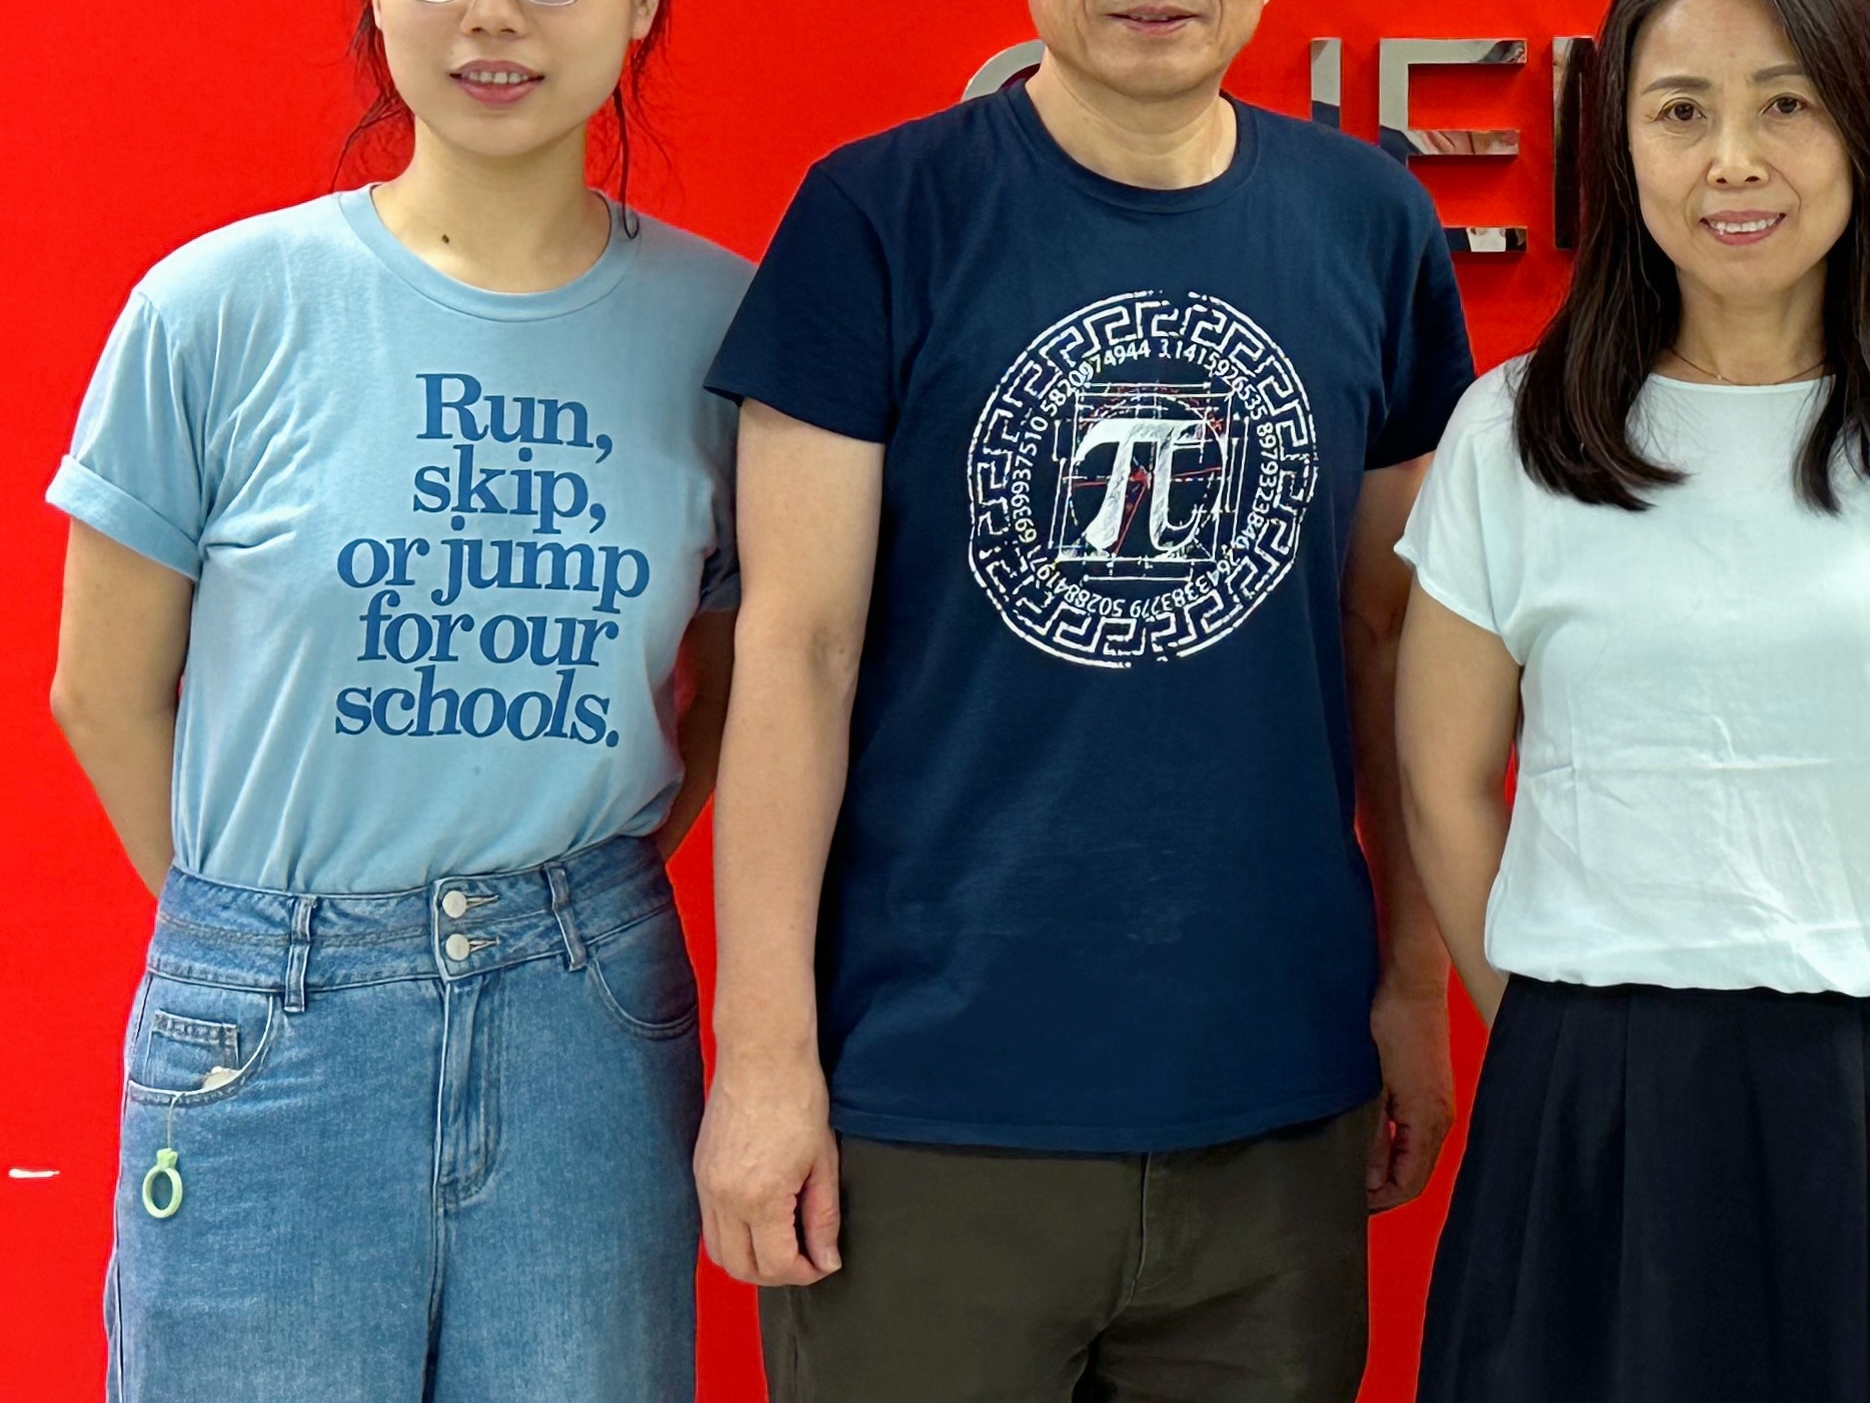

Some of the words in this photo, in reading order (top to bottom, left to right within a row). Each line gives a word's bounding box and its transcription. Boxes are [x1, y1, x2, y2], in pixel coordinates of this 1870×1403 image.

[415, 372, 614, 464] Run,
[412, 444, 607, 534] skip,
[336, 536, 431, 588] or
[430, 515, 651, 615] jump
[356, 589, 475, 665] for
[479, 613, 620, 667] our
[335, 664, 620, 748] schools.
